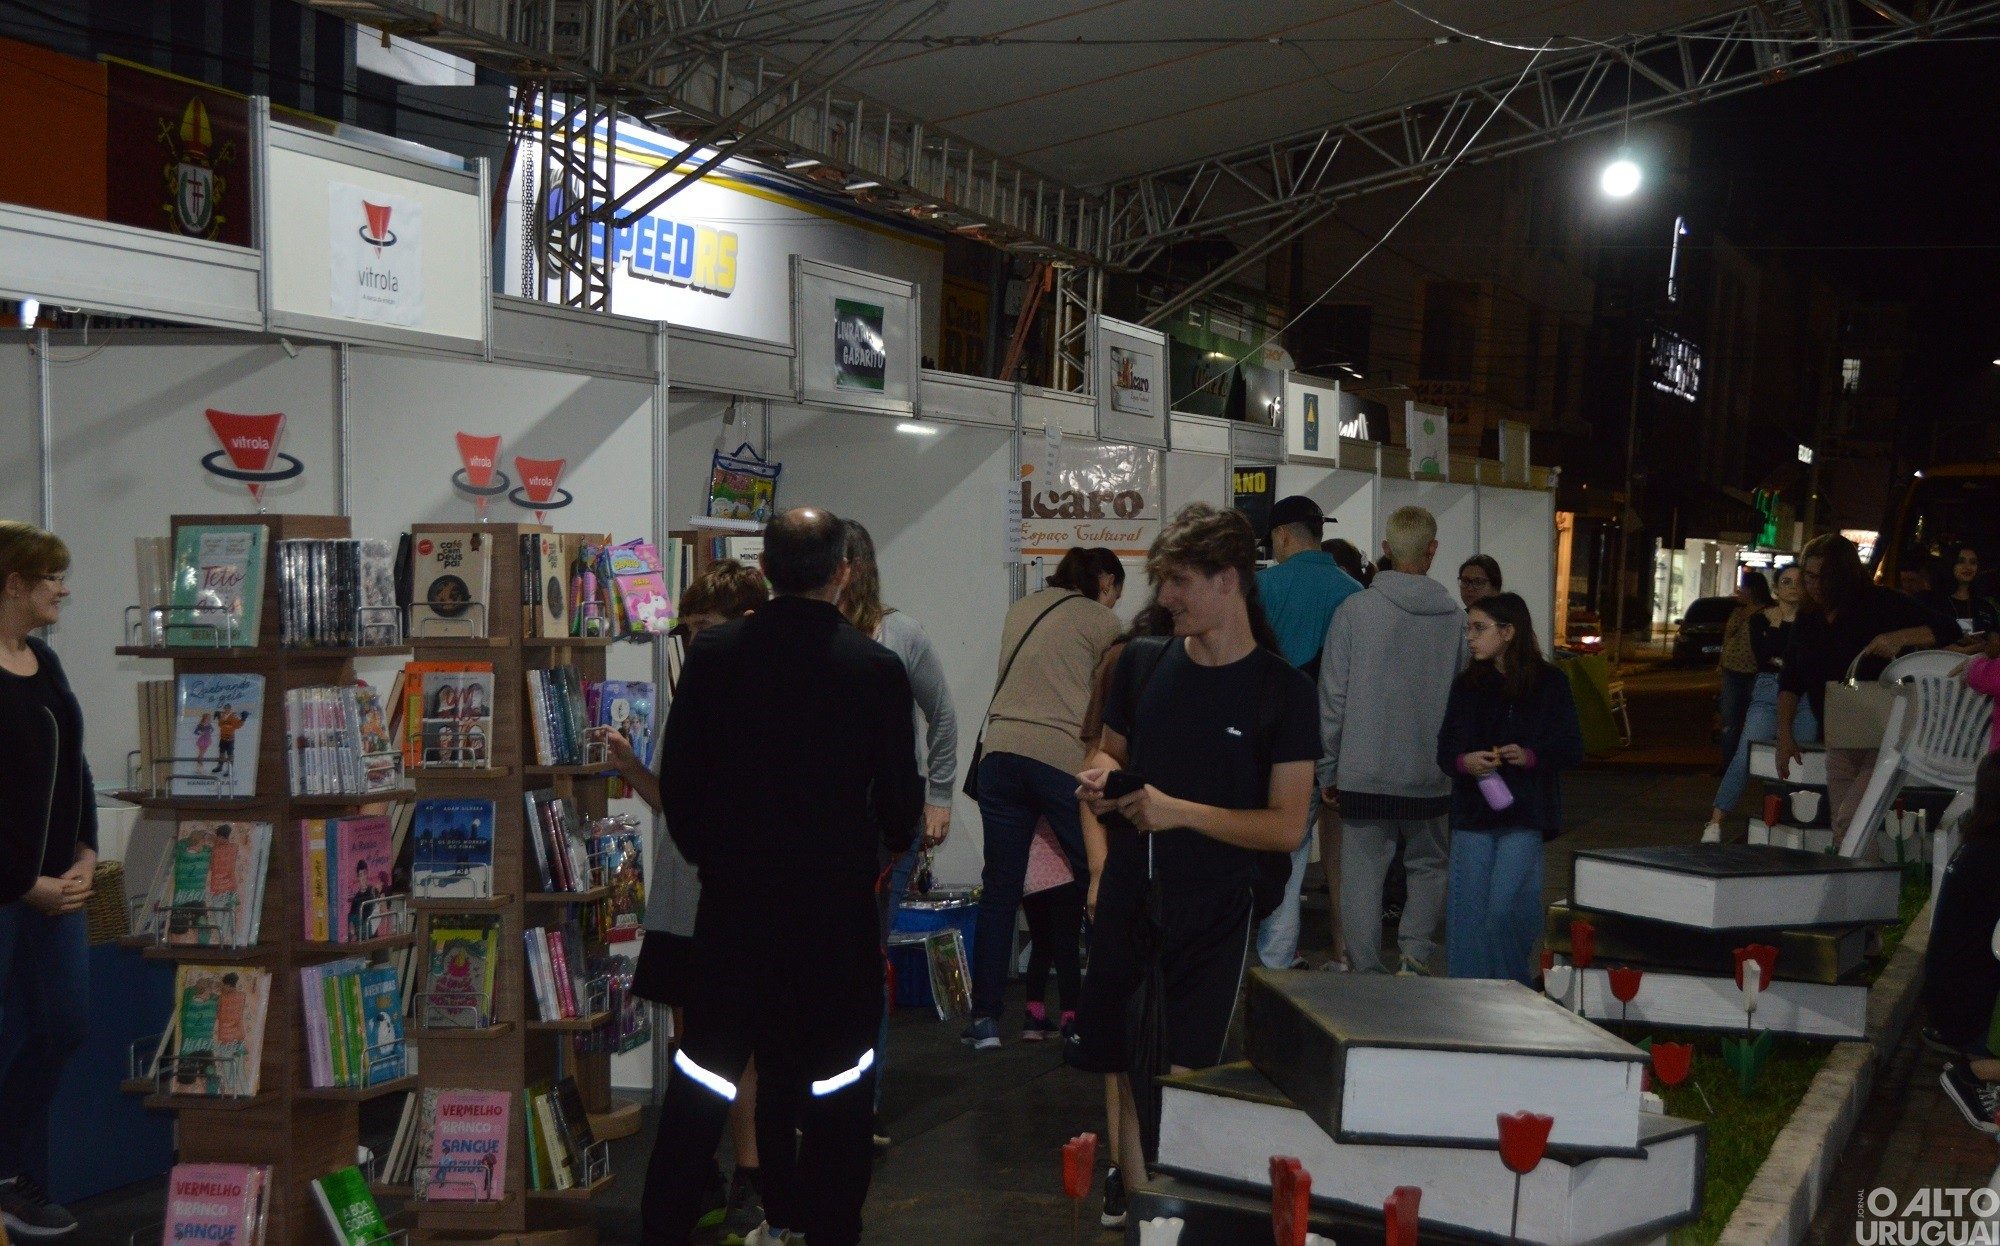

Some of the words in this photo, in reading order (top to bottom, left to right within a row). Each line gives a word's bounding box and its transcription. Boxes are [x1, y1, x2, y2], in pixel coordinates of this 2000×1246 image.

[358, 267, 399, 292] vitrola
[843, 346, 884, 369] GABARITO
[231, 436, 270, 450] vitrola
[470, 456, 492, 468] vitrola
[529, 476, 553, 487] vitrola
[1233, 472, 1266, 493] ANO
[1020, 522, 1069, 546] Espaço
[1074, 523, 1146, 542] Cultural
[201, 565, 246, 589] Teto
[442, 1104, 503, 1117] VERMELHO
[441, 1120, 492, 1134] BRANCO
[442, 1139, 499, 1153] SANGUE
[176, 1181, 241, 1197] VERMELHO
[174, 1200, 229, 1216] BRANCO
[175, 1222, 236, 1240] SANGUE
